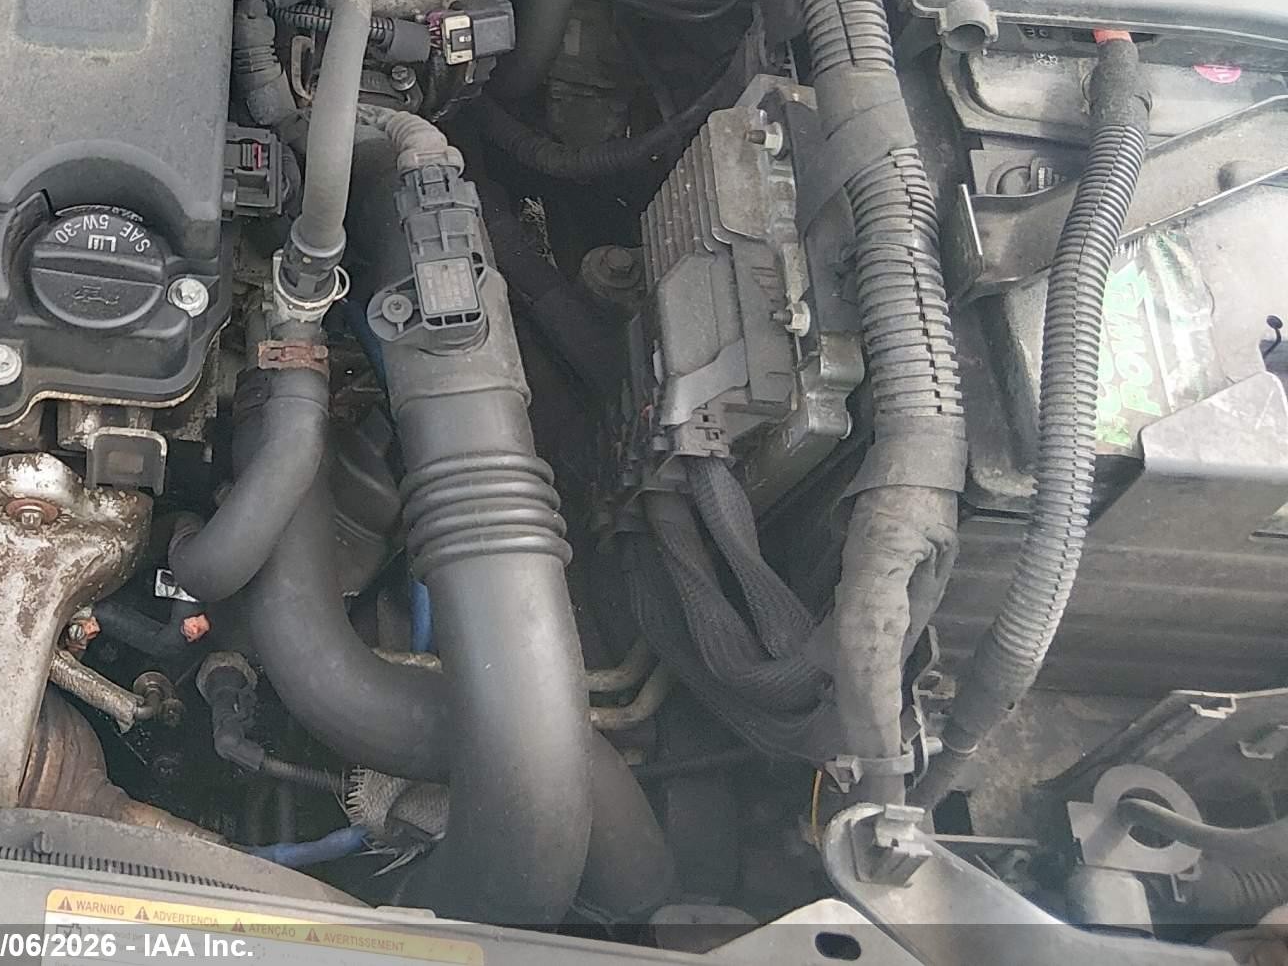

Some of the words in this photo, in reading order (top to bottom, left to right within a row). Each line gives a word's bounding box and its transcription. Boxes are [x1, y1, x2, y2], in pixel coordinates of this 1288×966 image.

[55, 214, 110, 244] 5W-30
[120, 222, 151, 252] SAE
[76, 900, 125, 916] WARNING
[152, 910, 220, 928] ADVERTENCIA
[248, 923, 296, 938] ATENÇÃO
[323, 932, 405, 952] AVERTISSEMENT
